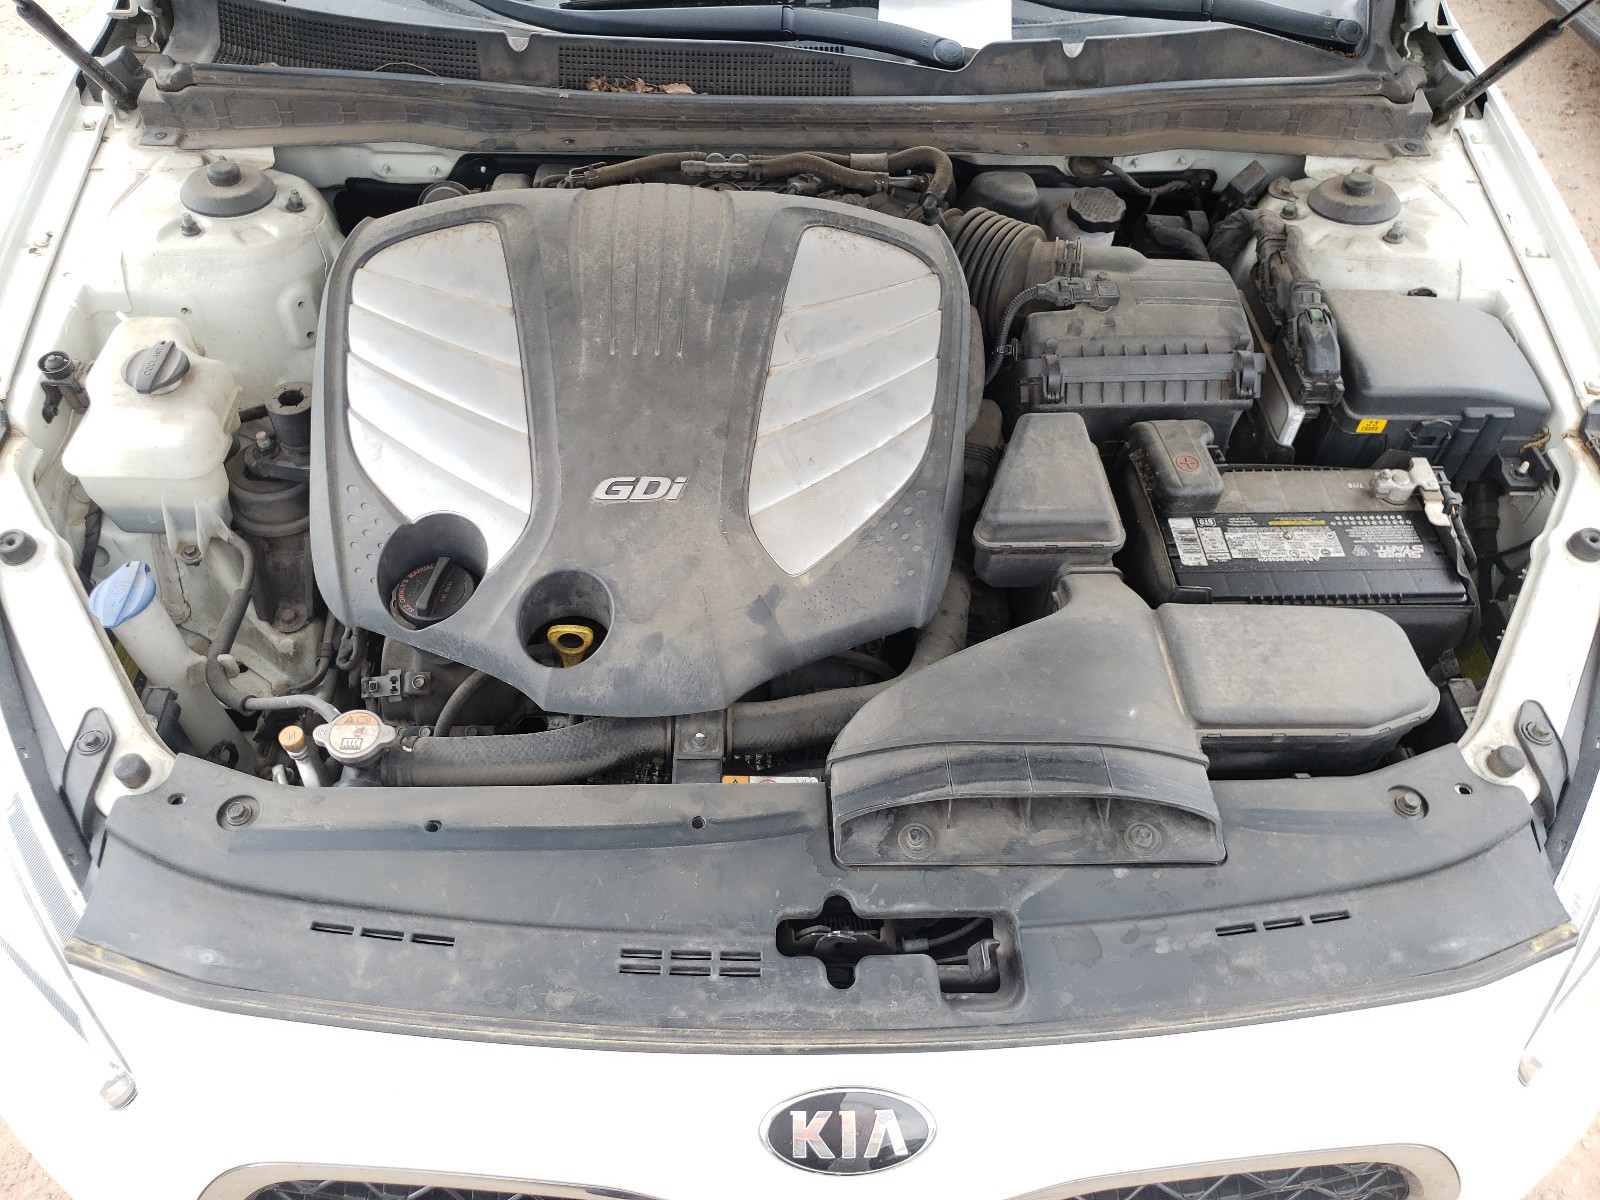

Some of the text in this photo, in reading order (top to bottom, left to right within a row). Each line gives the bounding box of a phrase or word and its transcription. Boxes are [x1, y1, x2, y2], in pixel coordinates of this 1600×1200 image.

[144, 348, 163, 376] COOLANT
[593, 476, 689, 501] GDi
[1377, 551, 1422, 559] SUPER
[1378, 544, 1424, 552] START
[790, 1109, 909, 1158] KIA
